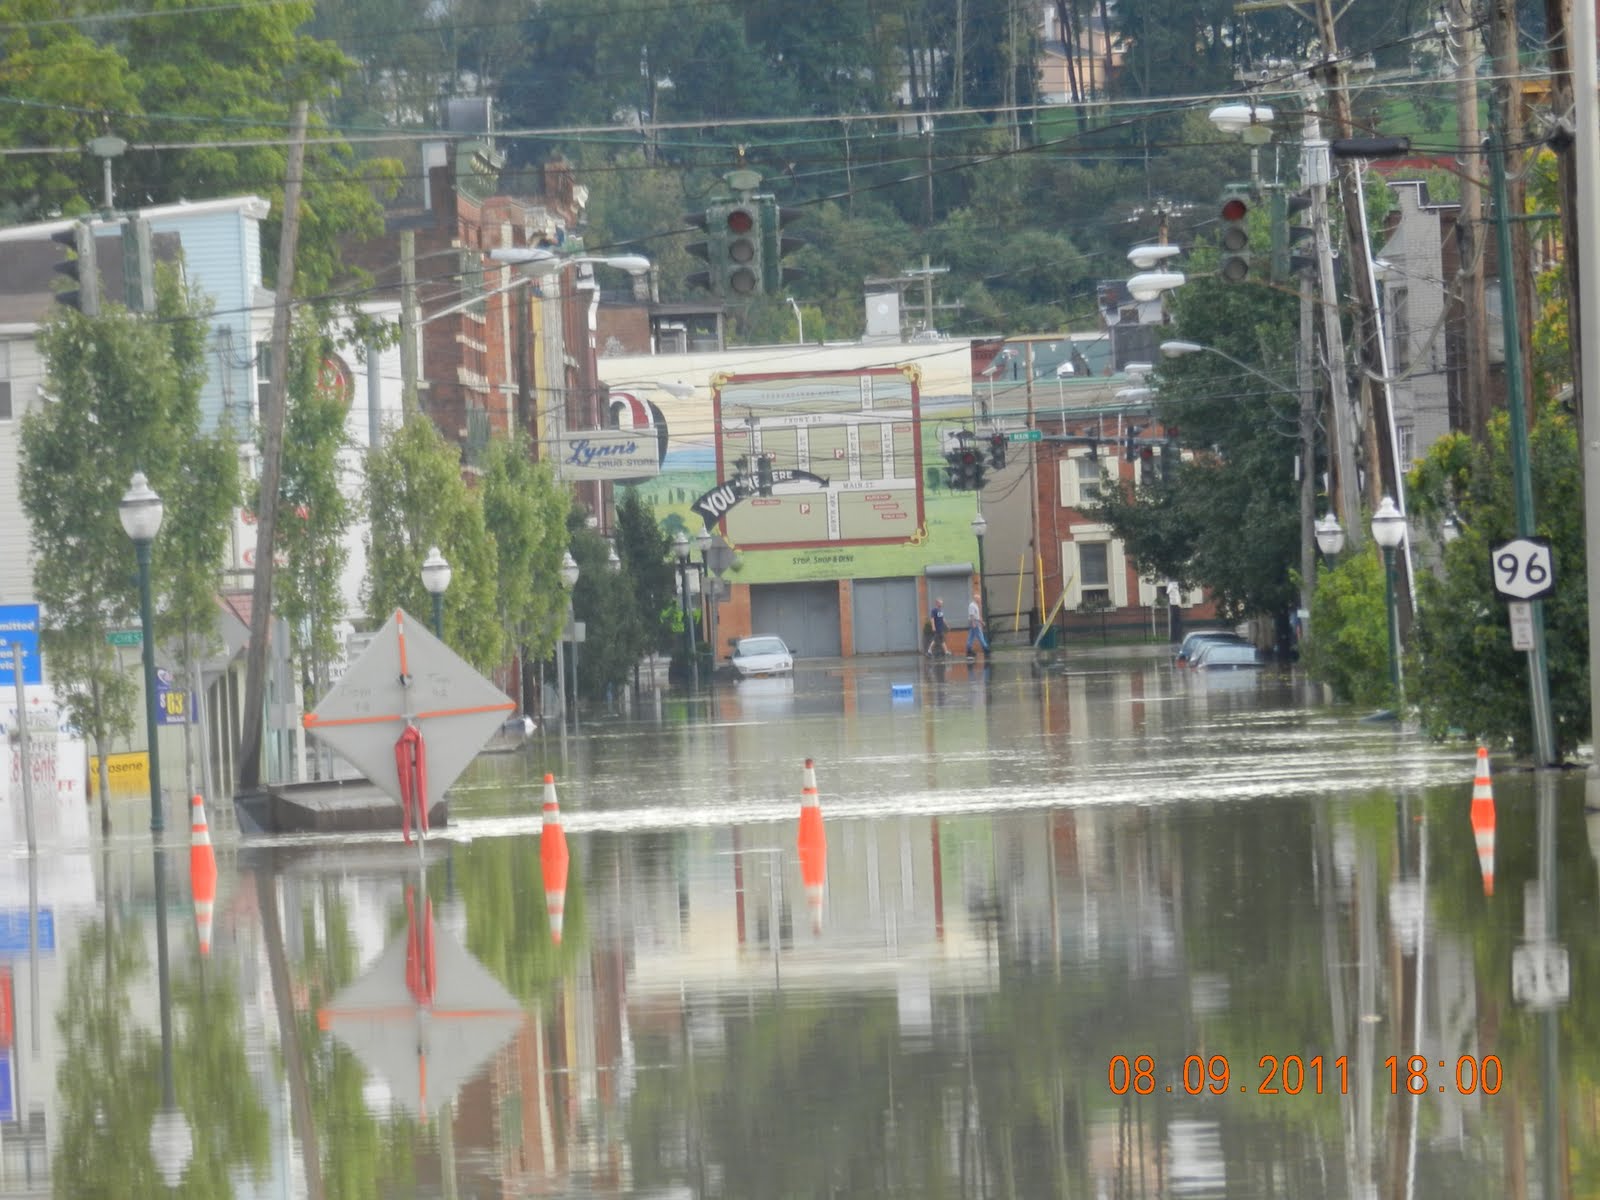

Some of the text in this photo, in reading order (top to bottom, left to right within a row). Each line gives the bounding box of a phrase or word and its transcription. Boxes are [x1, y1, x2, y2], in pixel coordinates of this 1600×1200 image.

[566, 440, 637, 468] Lynn's
[701, 485, 736, 518] YOU
[771, 470, 793, 483] ERE
[843, 482, 863, 490] MAIN
[1497, 552, 1547, 586] 96
